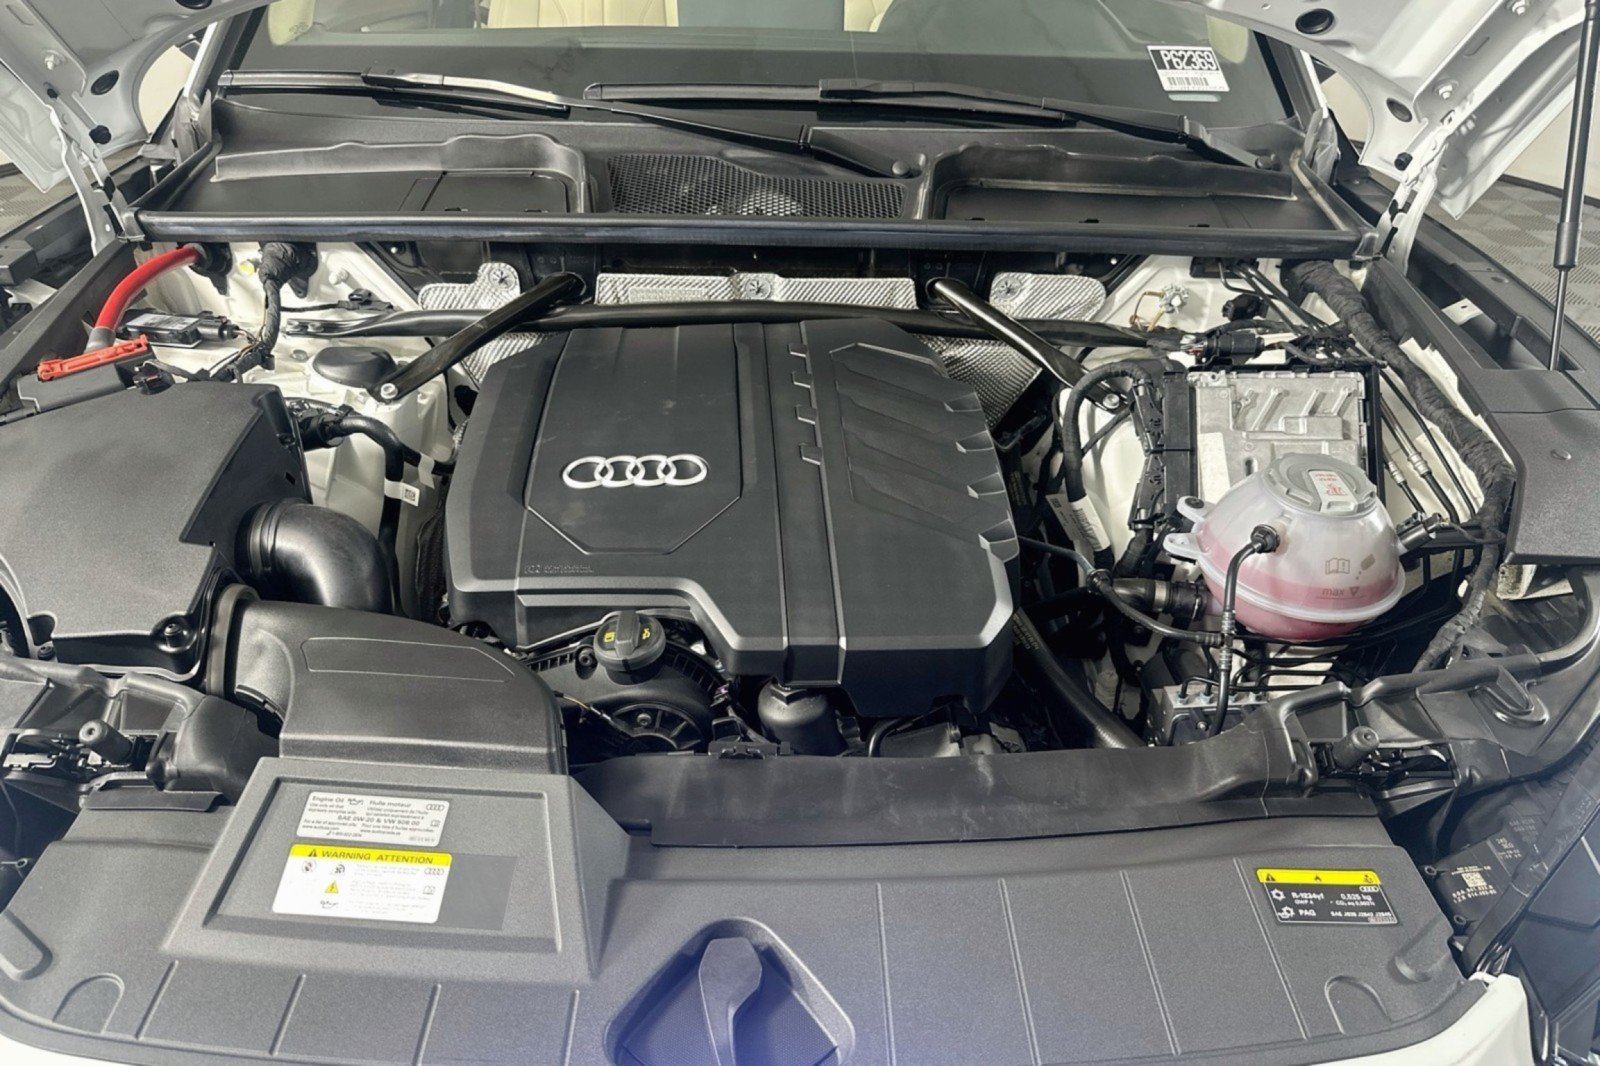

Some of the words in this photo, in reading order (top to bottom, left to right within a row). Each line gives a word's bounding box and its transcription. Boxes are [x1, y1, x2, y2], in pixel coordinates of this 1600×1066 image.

[1160, 50, 1217, 70] P62369
[1322, 587, 1345, 597] max
[321, 851, 371, 860] WARNING
[375, 854, 434, 864] ATTENTION
[1291, 892, 1324, 900] R-1234yf
[1361, 894, 1373, 902] kg
[1299, 909, 1317, 917] PAG
